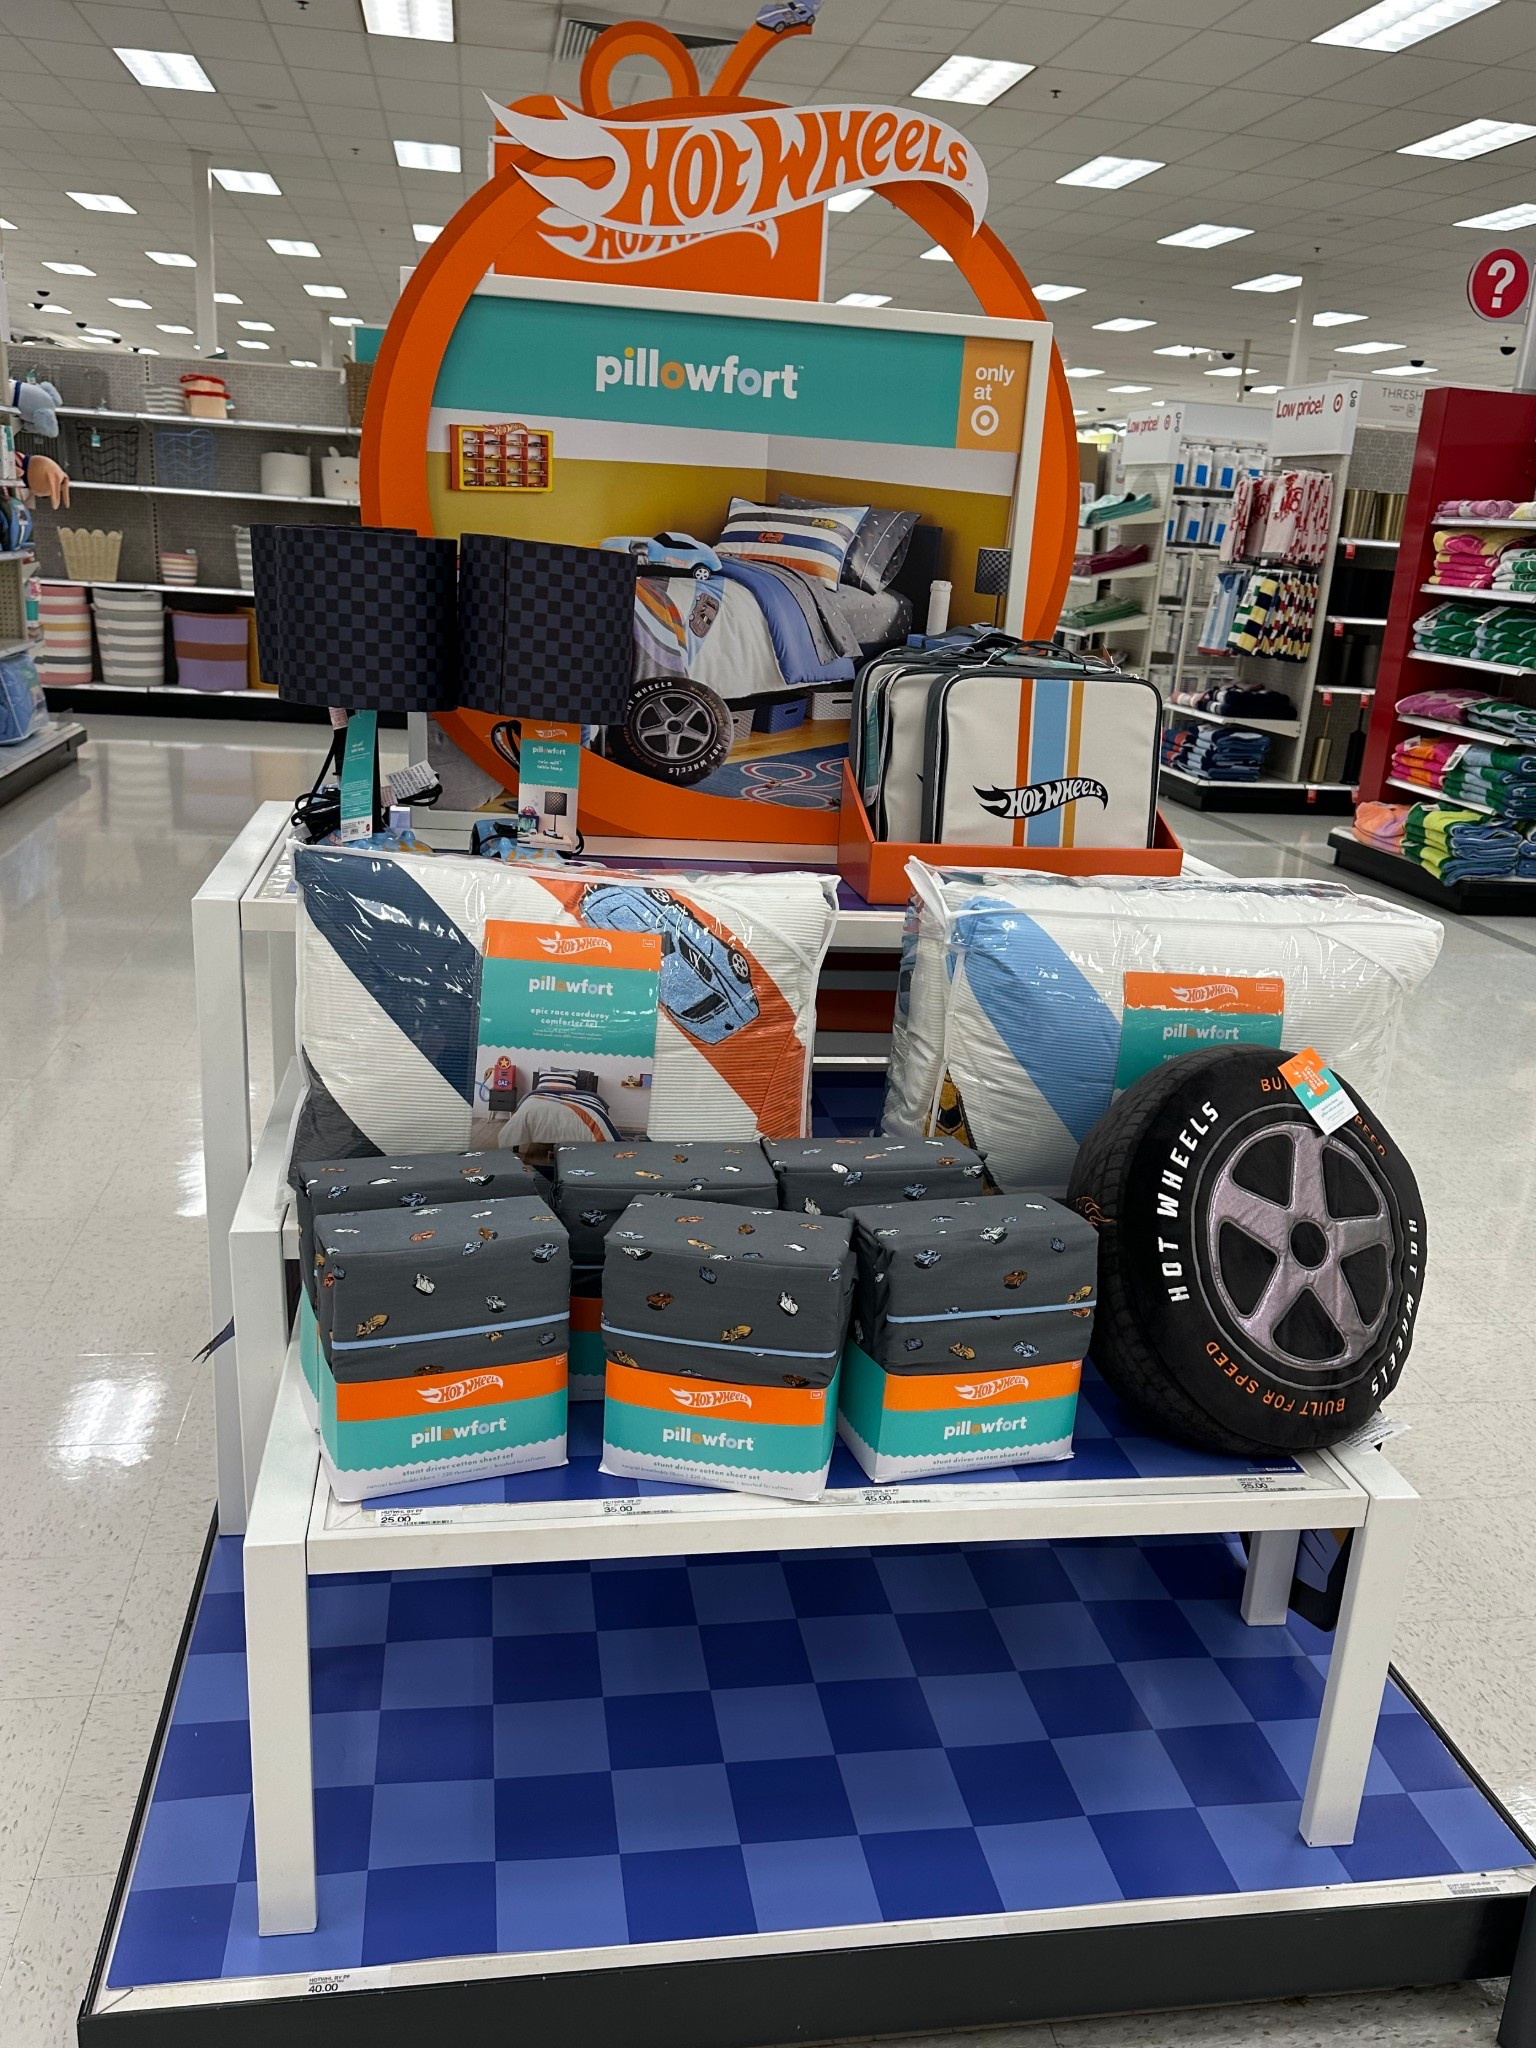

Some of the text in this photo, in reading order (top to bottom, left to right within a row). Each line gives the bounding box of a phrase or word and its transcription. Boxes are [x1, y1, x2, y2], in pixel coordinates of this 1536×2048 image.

[600, 125, 752, 226] HOT
[595, 347, 798, 400] pillowfort
[975, 364, 1015, 385] only
[974, 384, 993, 400] at
[1276, 394, 1325, 421] Low price!
[1127, 416, 1159, 435] Low price!
[635, 681, 672, 698] WHEELS
[532, 746, 566, 756] pillowfort
[668, 759, 707, 776] WHEELS
[1003, 788, 1044, 817] HOT
[528, 976, 614, 996] pillowfort
[1187, 989, 1206, 1001] HOT
[541, 1017, 583, 1027] comforter
[571, 1010, 610, 1020] corduroy
[1163, 1023, 1240, 1040] pillowfort
[1157, 1101, 1219, 1302] HOT WHEELS
[1371, 1219, 1418, 1397] HOT WHEELS
[1206, 1341, 1345, 1416] BUILT FOR SPEED
[439, 1385, 462, 1402] HOT
[689, 1393, 712, 1406] HOT
[973, 1384, 994, 1398] HOT
[411, 1417, 506, 1448] pillowfort
[944, 1416, 1027, 1440] pillowfort
[662, 1427, 754, 1451] pillowfort
[402, 1468, 424, 1476] stunt
[425, 1464, 451, 1474] driver
[451, 1460, 478, 1468] cotton
[479, 1455, 500, 1464] sheet
[675, 1463, 697, 1471] driver
[699, 1467, 724, 1476] cotton
[726, 1471, 747, 1479] sheet
[604, 1505, 632, 1513] 35.00
[308, 1983, 339, 1993] 40.00
